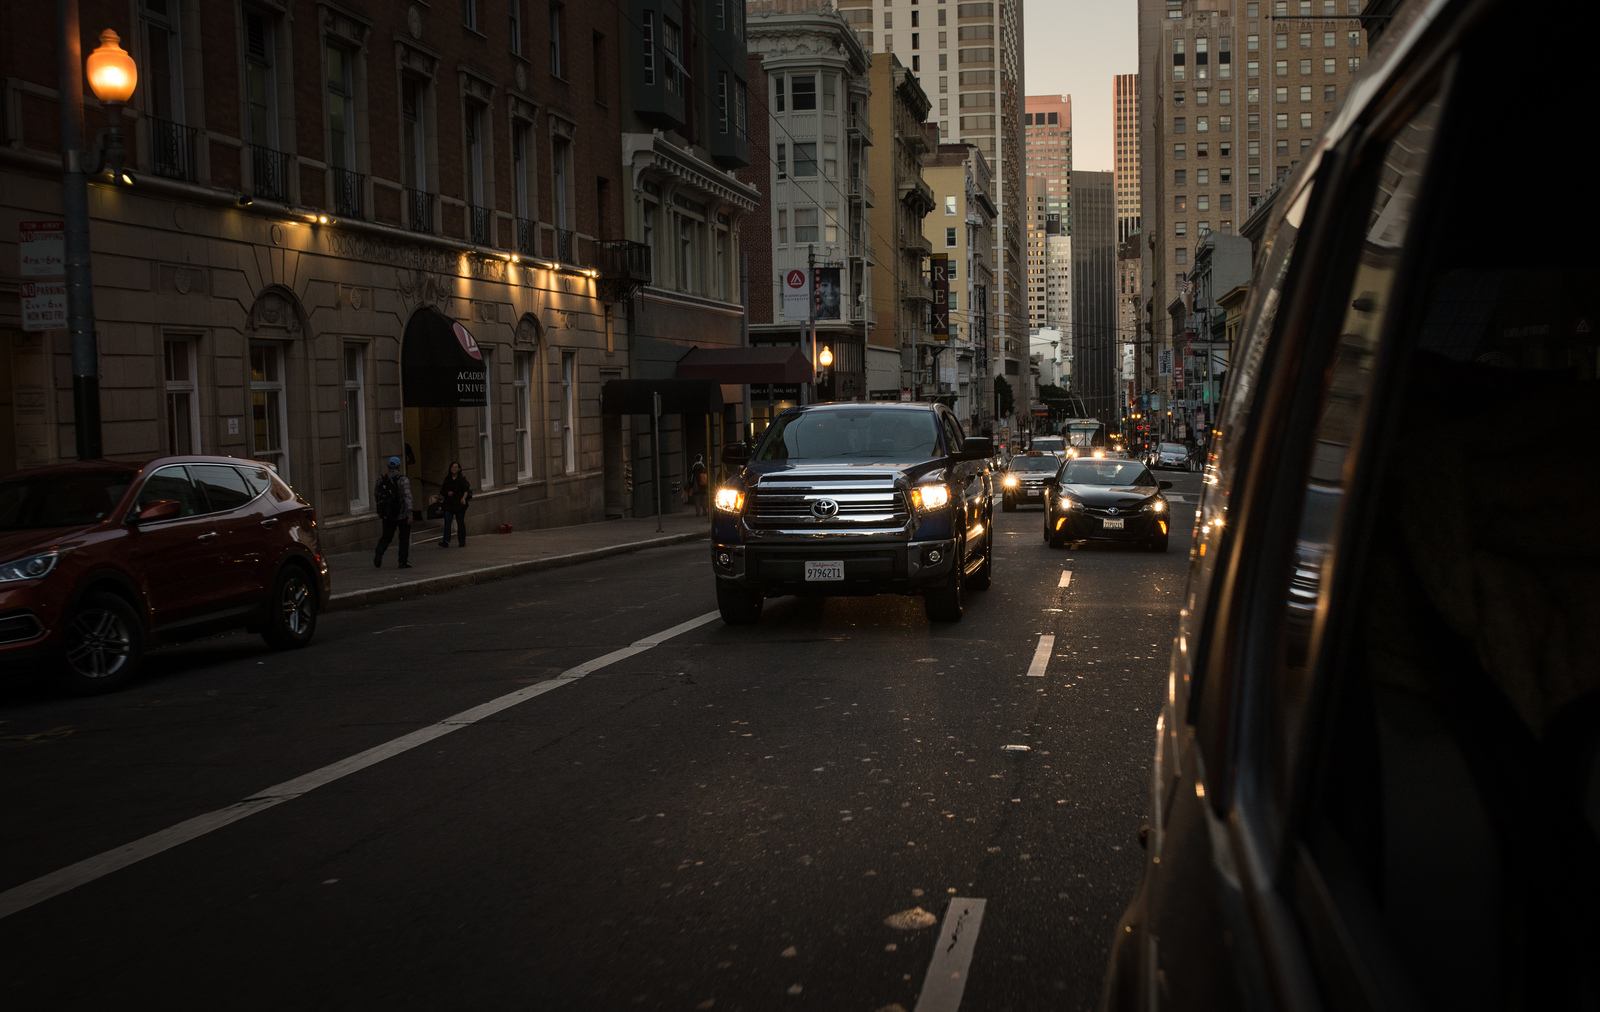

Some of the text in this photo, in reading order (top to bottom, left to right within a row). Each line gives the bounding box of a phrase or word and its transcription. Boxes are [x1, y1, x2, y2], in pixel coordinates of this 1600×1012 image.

[22, 284, 36, 298] NO
[933, 266, 946, 329] REX
[807, 568, 842, 578] 97962T1
